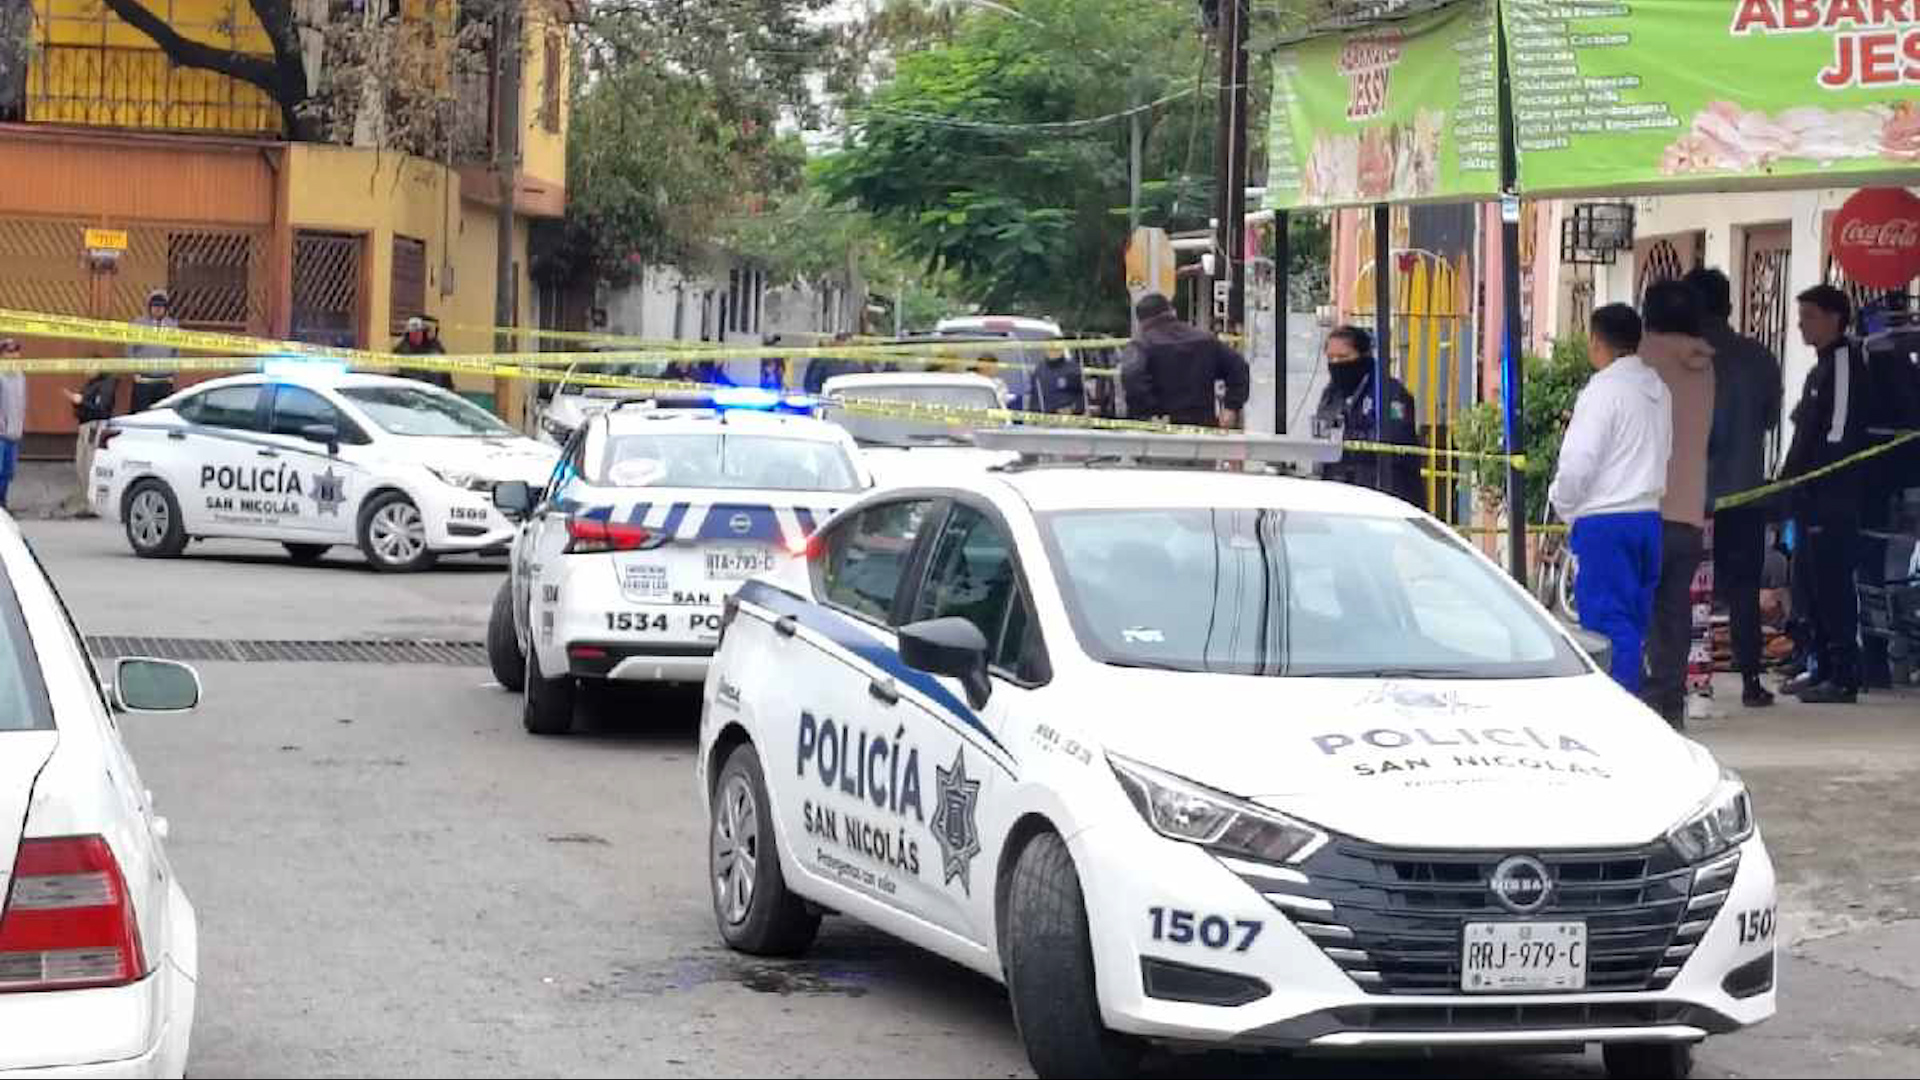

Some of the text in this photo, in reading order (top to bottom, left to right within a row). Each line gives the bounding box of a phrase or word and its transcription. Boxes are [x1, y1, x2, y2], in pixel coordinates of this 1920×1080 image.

[201, 462, 303, 495] POLICÍA
[206, 497, 300, 514] SAN NICOLÁS
[672, 592, 711, 603] SAN
[605, 612, 668, 631] 1534
[797, 711, 925, 823] POLICÍA
[1353, 756, 1432, 777] SAN
[803, 801, 919, 874] SAN NICOLÁS
[1149, 906, 1265, 952] 1507
[1468, 940, 1581, 970] RRJ-979-C
